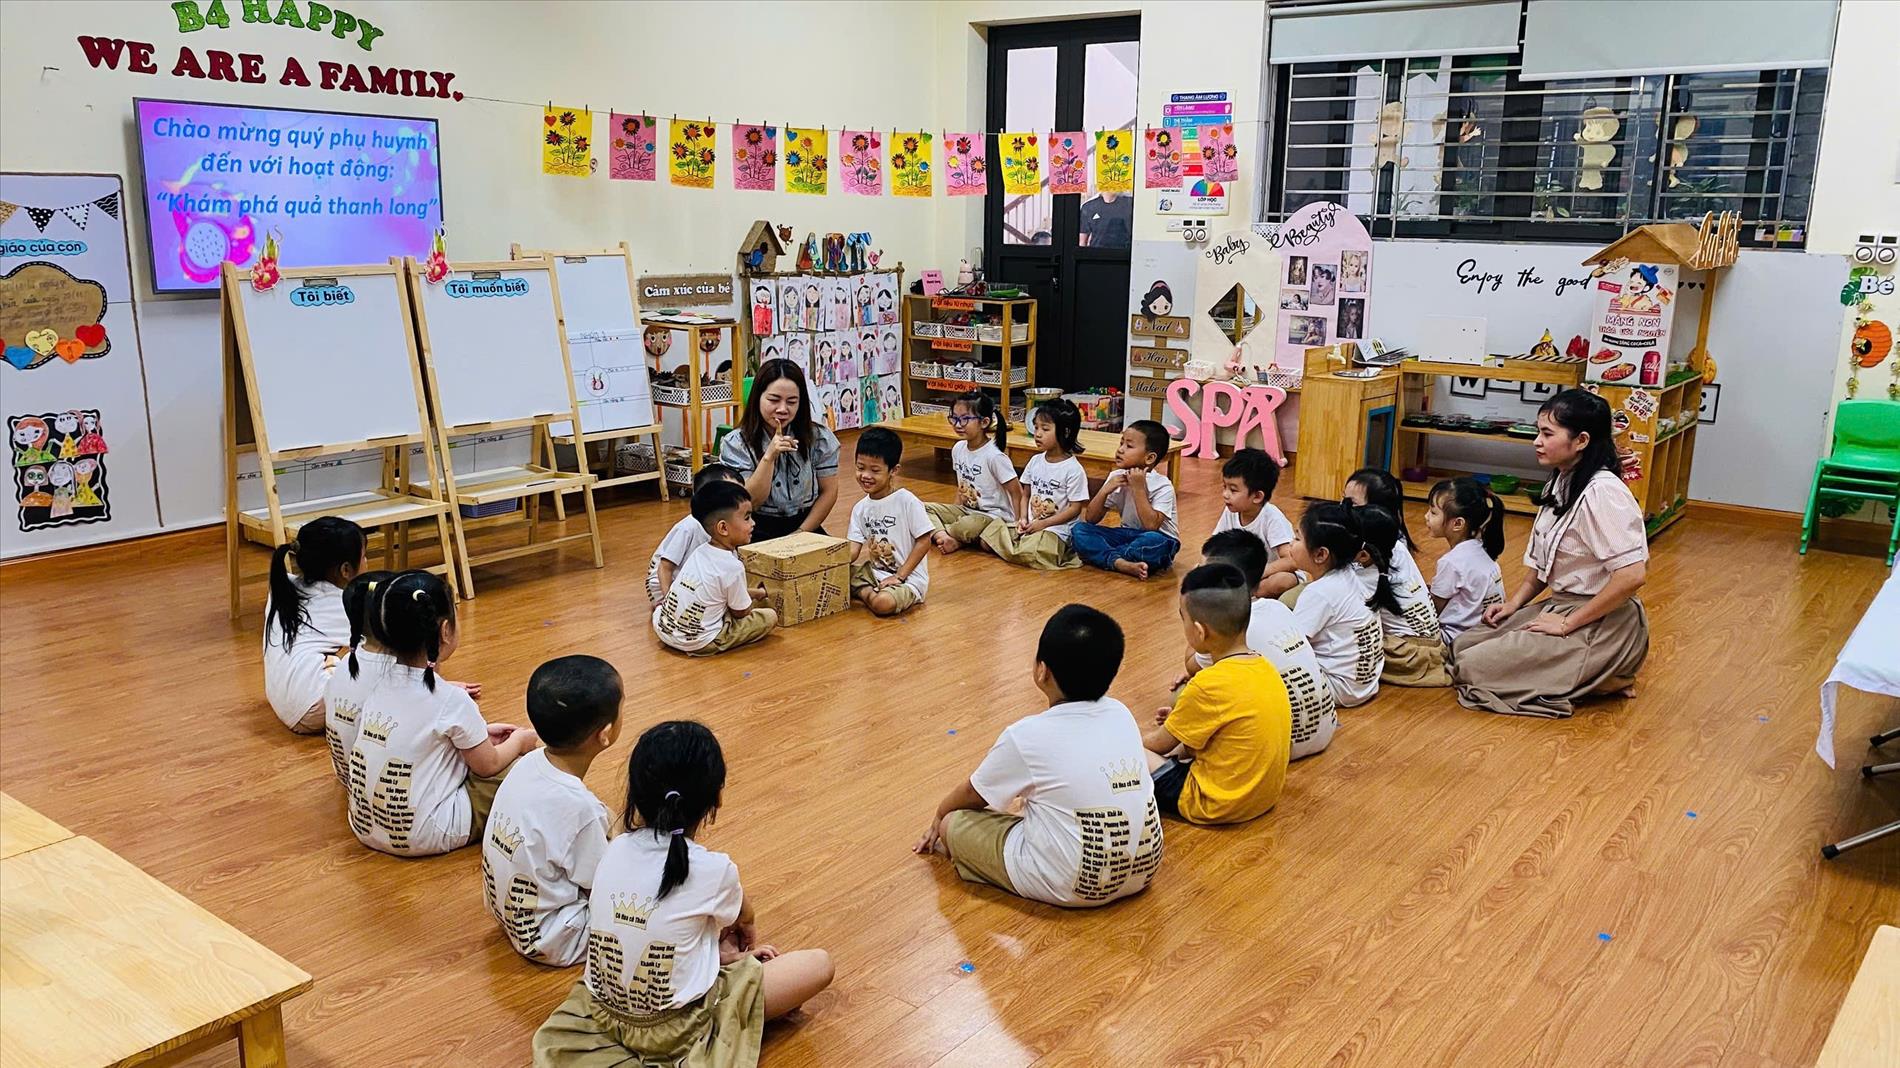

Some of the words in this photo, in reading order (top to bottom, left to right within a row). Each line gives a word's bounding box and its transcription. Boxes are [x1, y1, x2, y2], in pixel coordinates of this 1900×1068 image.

[171, 0, 231, 34] B4
[241, 0, 384, 52] HAPPY
[77, 35, 158, 75] WE
[171, 46, 267, 85] ARE
[279, 57, 312, 88] A
[153, 117, 211, 139] Chào
[217, 121, 281, 147] mừng
[287, 126, 325, 150] quý
[329, 128, 366, 150] phụ
[372, 130, 428, 152] huynh
[200, 151, 243, 174] đến
[249, 155, 283, 176] với
[289, 156, 335, 177] hoạt
[340, 160, 395, 182] động:
[238, 193, 278, 218] phá
[284, 195, 322, 218] quả
[327, 196, 384, 215] thanh
[30, 240, 55, 252] của
[57, 243, 82, 252] con
[1205, 234, 1250, 266] Baby
[450, 283, 469, 295] Tôi
[472, 281, 504, 295] muốn
[504, 281, 527, 293] biết
[1456, 258, 1504, 294] Enjoy
[1517, 266, 1544, 288] the
[1558, 273, 1592, 297] good
[1858, 274, 1895, 295] Bé
[298, 290, 322, 302] Tôi
[323, 287, 350, 302] biết
[643, 283, 671, 298] Cảm
[673, 282, 693, 296] xúc
[695, 281, 717, 295] của
[718, 281, 731, 294] bé
[1144, 319, 1173, 333] Nail
[1638, 317, 1660, 327] NON
[1144, 350, 1169, 364] Hair
[1130, 379, 1160, 393] Make
[1166, 378, 1288, 468] SPA
